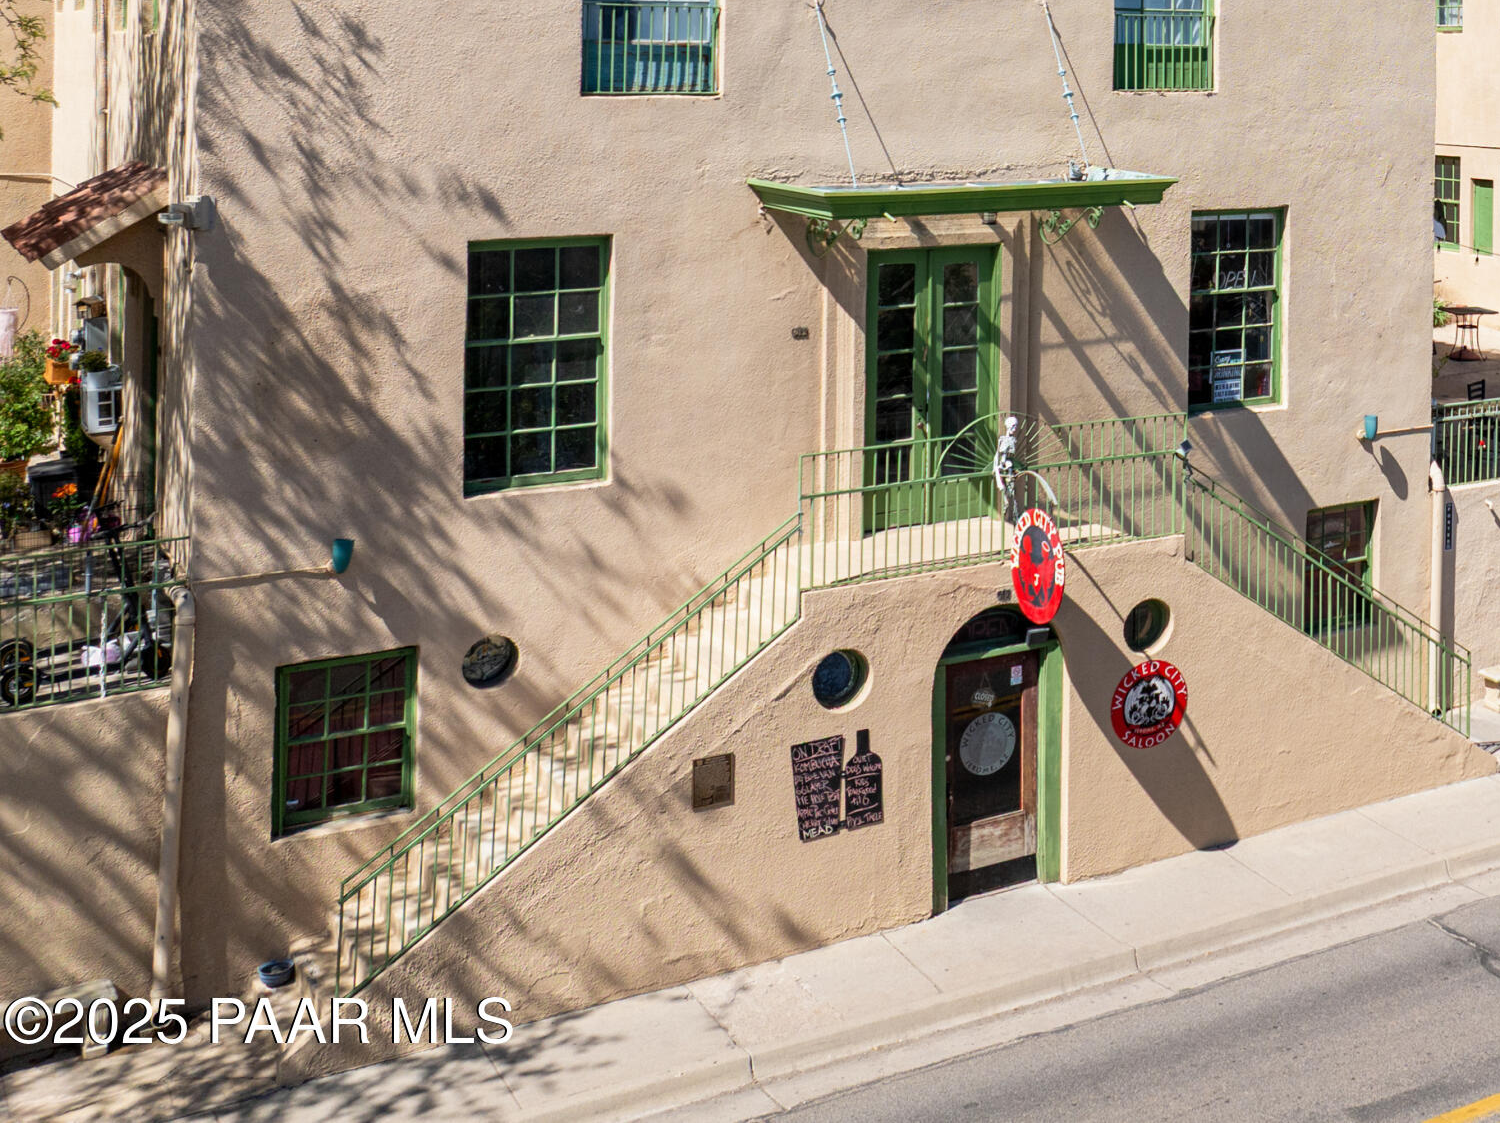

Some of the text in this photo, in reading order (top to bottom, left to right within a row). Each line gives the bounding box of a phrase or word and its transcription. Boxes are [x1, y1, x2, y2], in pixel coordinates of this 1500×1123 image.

[1010, 508, 1064, 586] WICKED CITY PUB
[1112, 661, 1187, 710] WICKED CITY
[961, 714, 1015, 748] WICKED CITY
[1122, 724, 1175, 748] SALOON
[792, 736, 841, 761] ON DRAFT
[803, 825, 834, 841] MEAD
